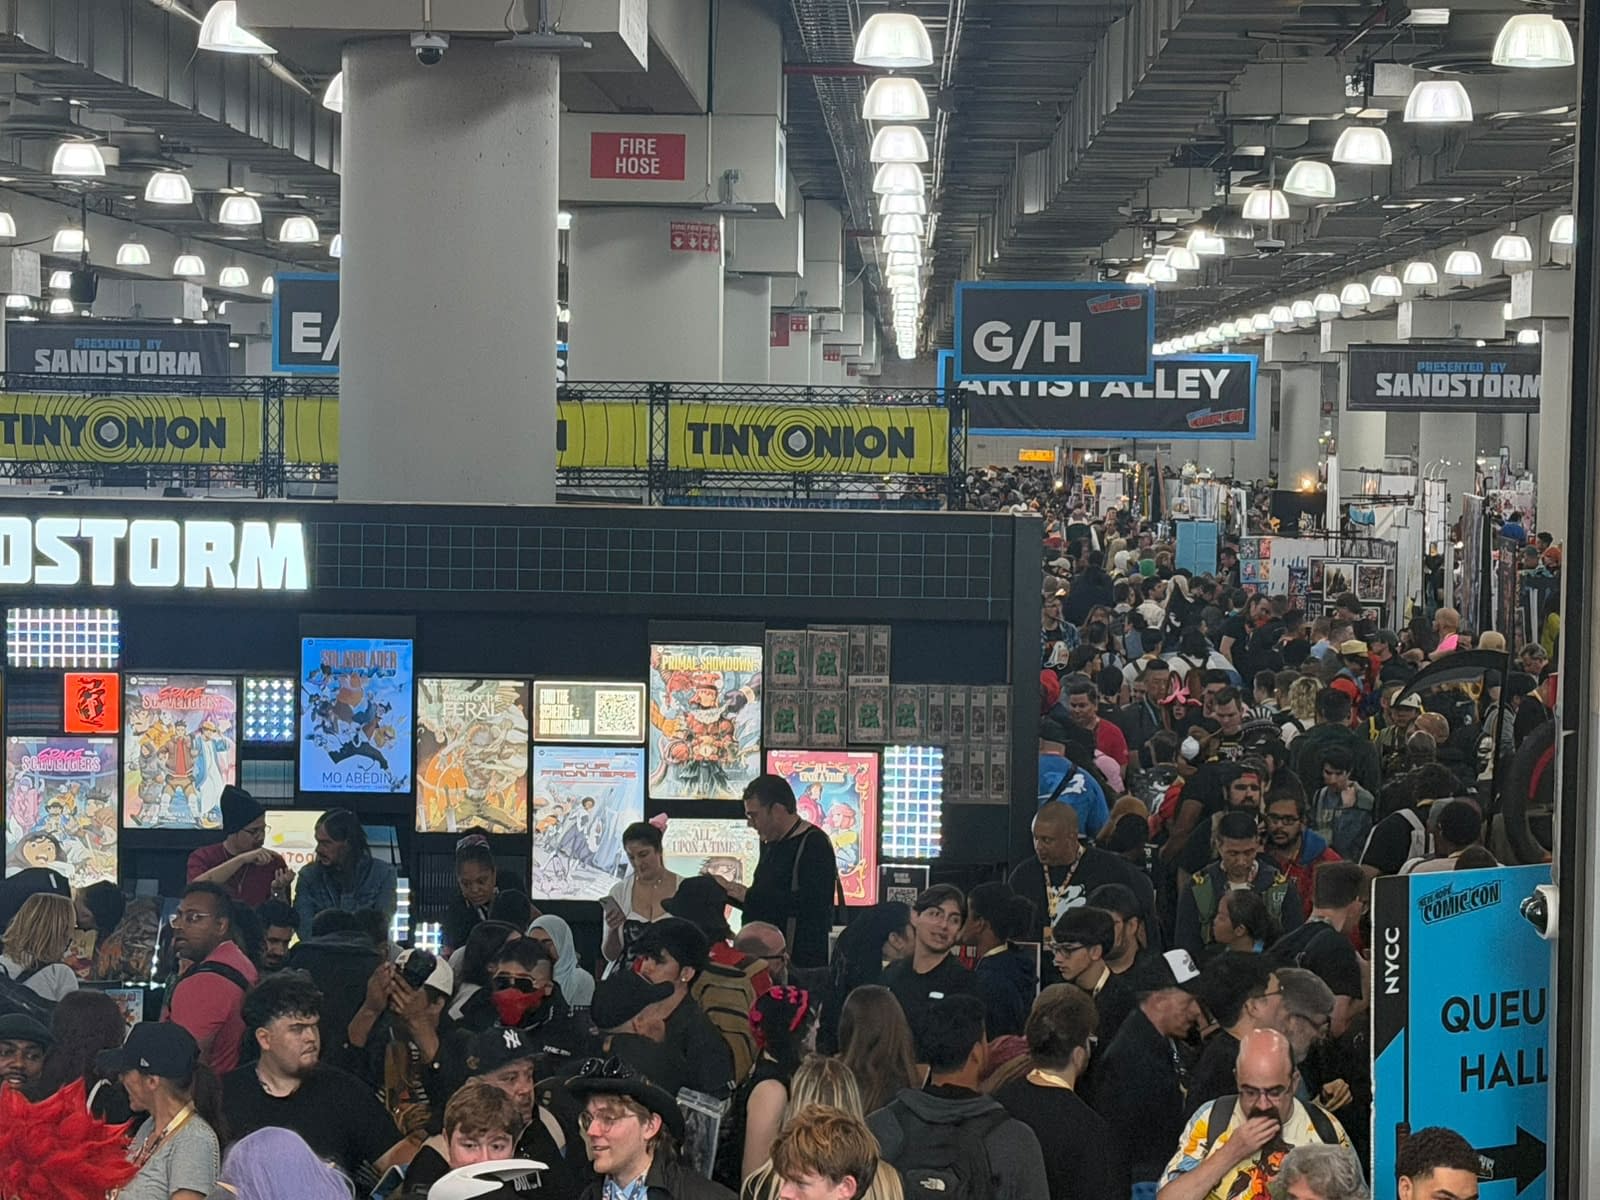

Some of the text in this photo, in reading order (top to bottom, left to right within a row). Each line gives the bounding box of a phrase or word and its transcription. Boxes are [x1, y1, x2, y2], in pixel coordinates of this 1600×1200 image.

[619, 137, 656, 156] FIRE
[615, 157, 660, 175] HOSE
[75, 338, 162, 350] PRESENTED BY
[972, 319, 1082, 370] G/H
[35, 349, 202, 375] SANDSTORM
[1417, 362, 1507, 373] PRESENTED BY
[1100, 368, 1231, 399] ALLEY
[1376, 373, 1540, 397] SANDSTORM
[662, 655, 754, 672] PRIMAL SHOWDOWN
[442, 701, 501, 719] FERAL
[540, 769, 637, 779] FRONTIERS
[563, 762, 610, 770] FOUR
[322, 771, 392, 785] MO ABEDIN
[692, 828, 712, 841] ALL
[1423, 882, 1500, 922] COMIC CON
[1384, 926, 1401, 995] NYCC
[1441, 987, 1547, 1034] QUEU
[1460, 1047, 1548, 1092] HALL
